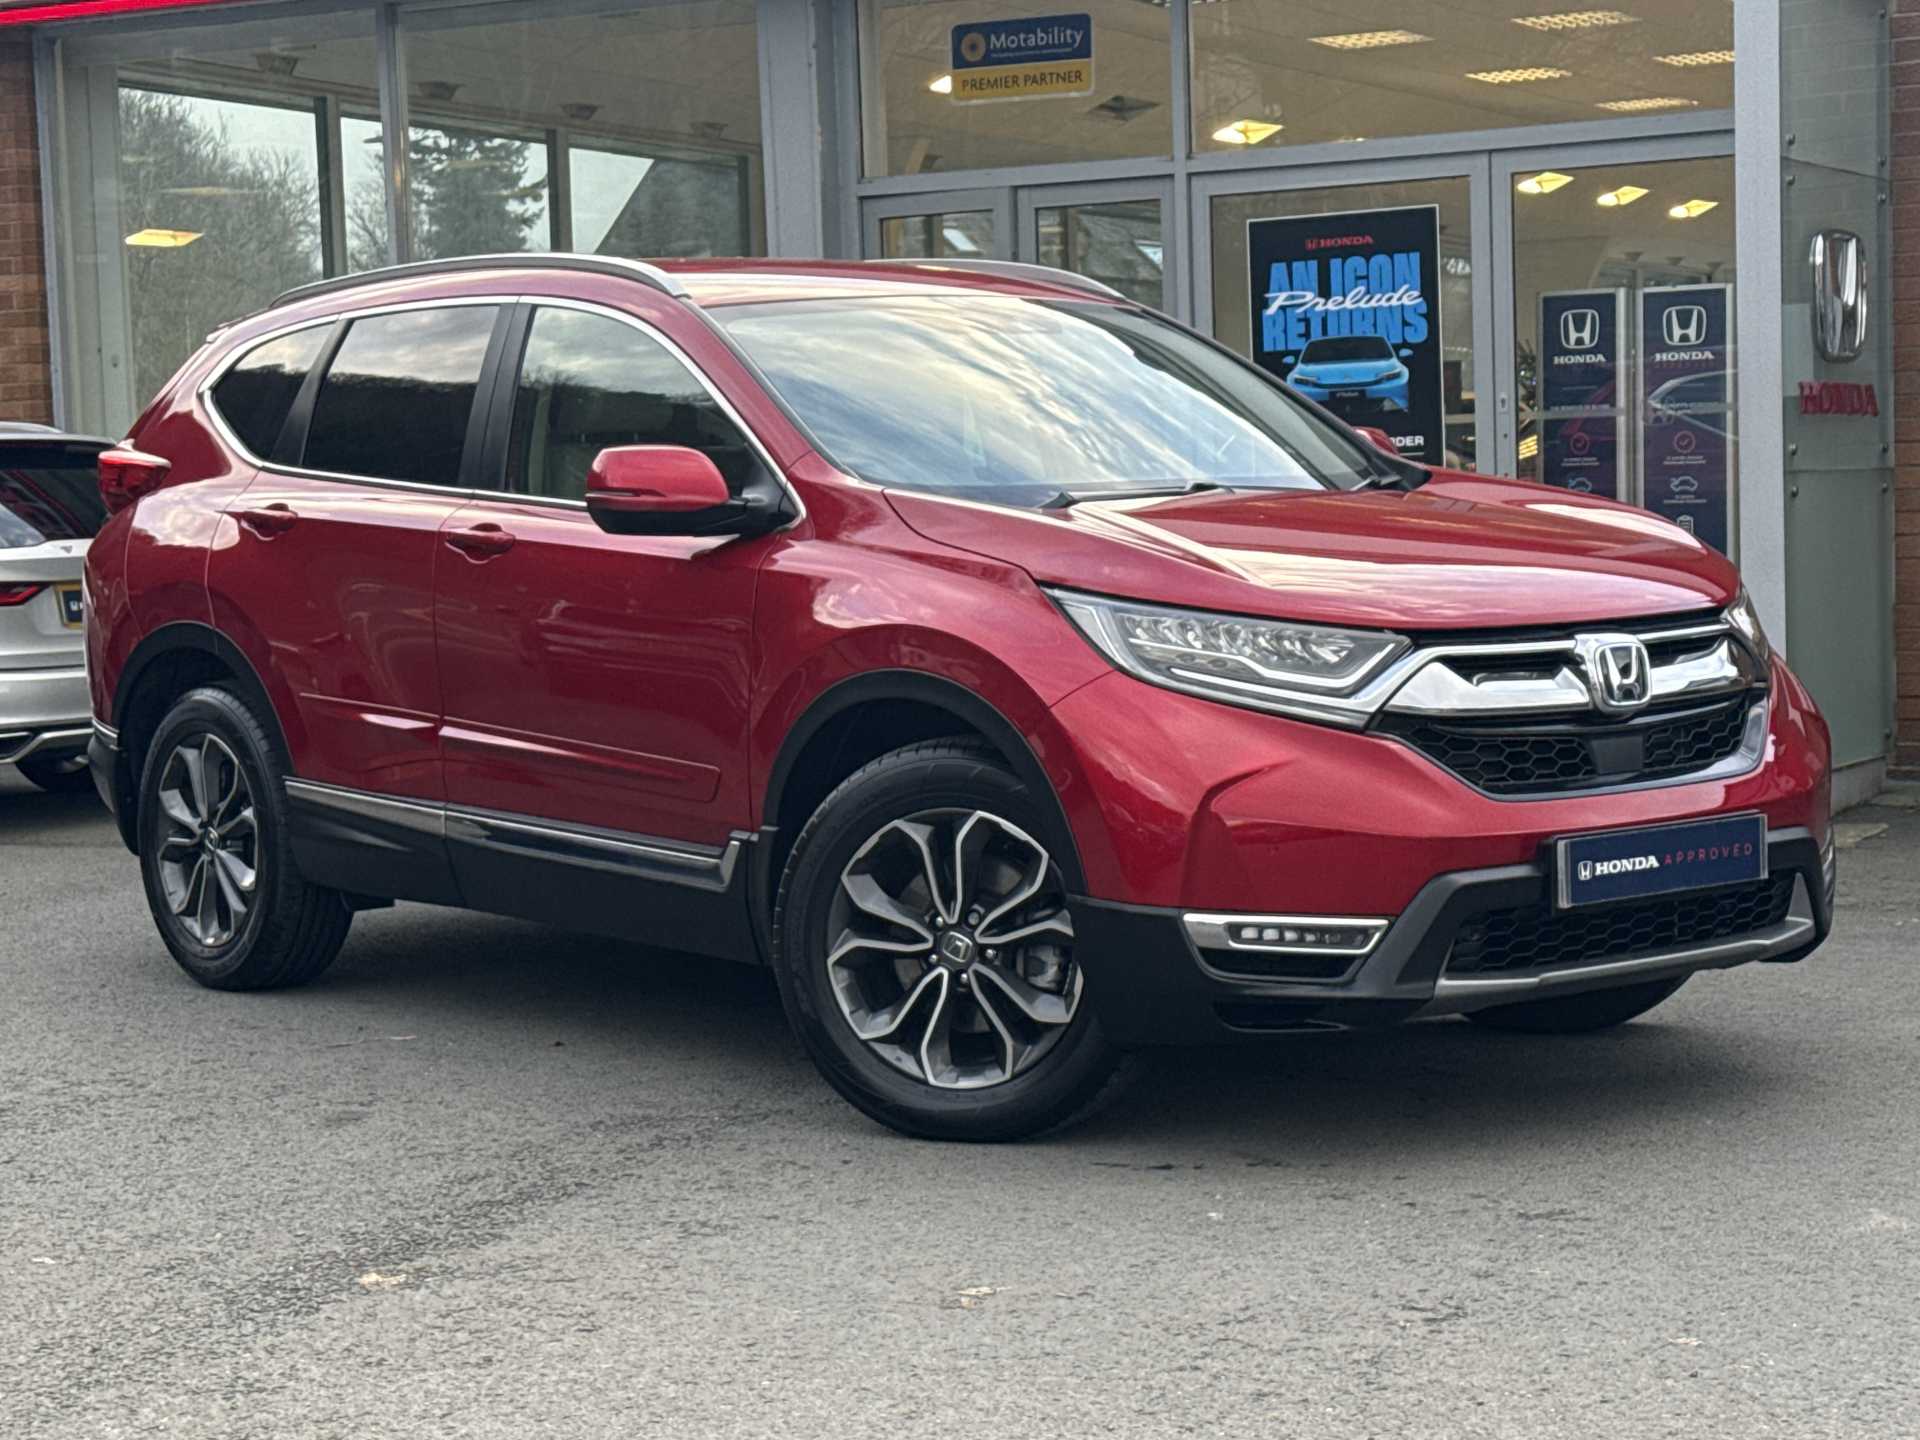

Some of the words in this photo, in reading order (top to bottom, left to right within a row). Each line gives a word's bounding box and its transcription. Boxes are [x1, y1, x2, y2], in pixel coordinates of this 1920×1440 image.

[989, 26, 1084, 49] Motability
[961, 75, 1020, 92] PREMIER
[1023, 70, 1083, 87] PARTNER
[1319, 235, 1374, 248] HONDA
[1269, 260, 1318, 304] AN
[1329, 252, 1420, 299] ICON
[1264, 284, 1423, 315] Prelude
[1262, 299, 1428, 351] RETURNS
[1553, 353, 1606, 364] HONDA
[1654, 351, 1714, 361] HONDA
[1798, 381, 1879, 416] HONDA
[1595, 855, 1660, 876] HONDA
[1664, 842, 1753, 865] APPROVED
